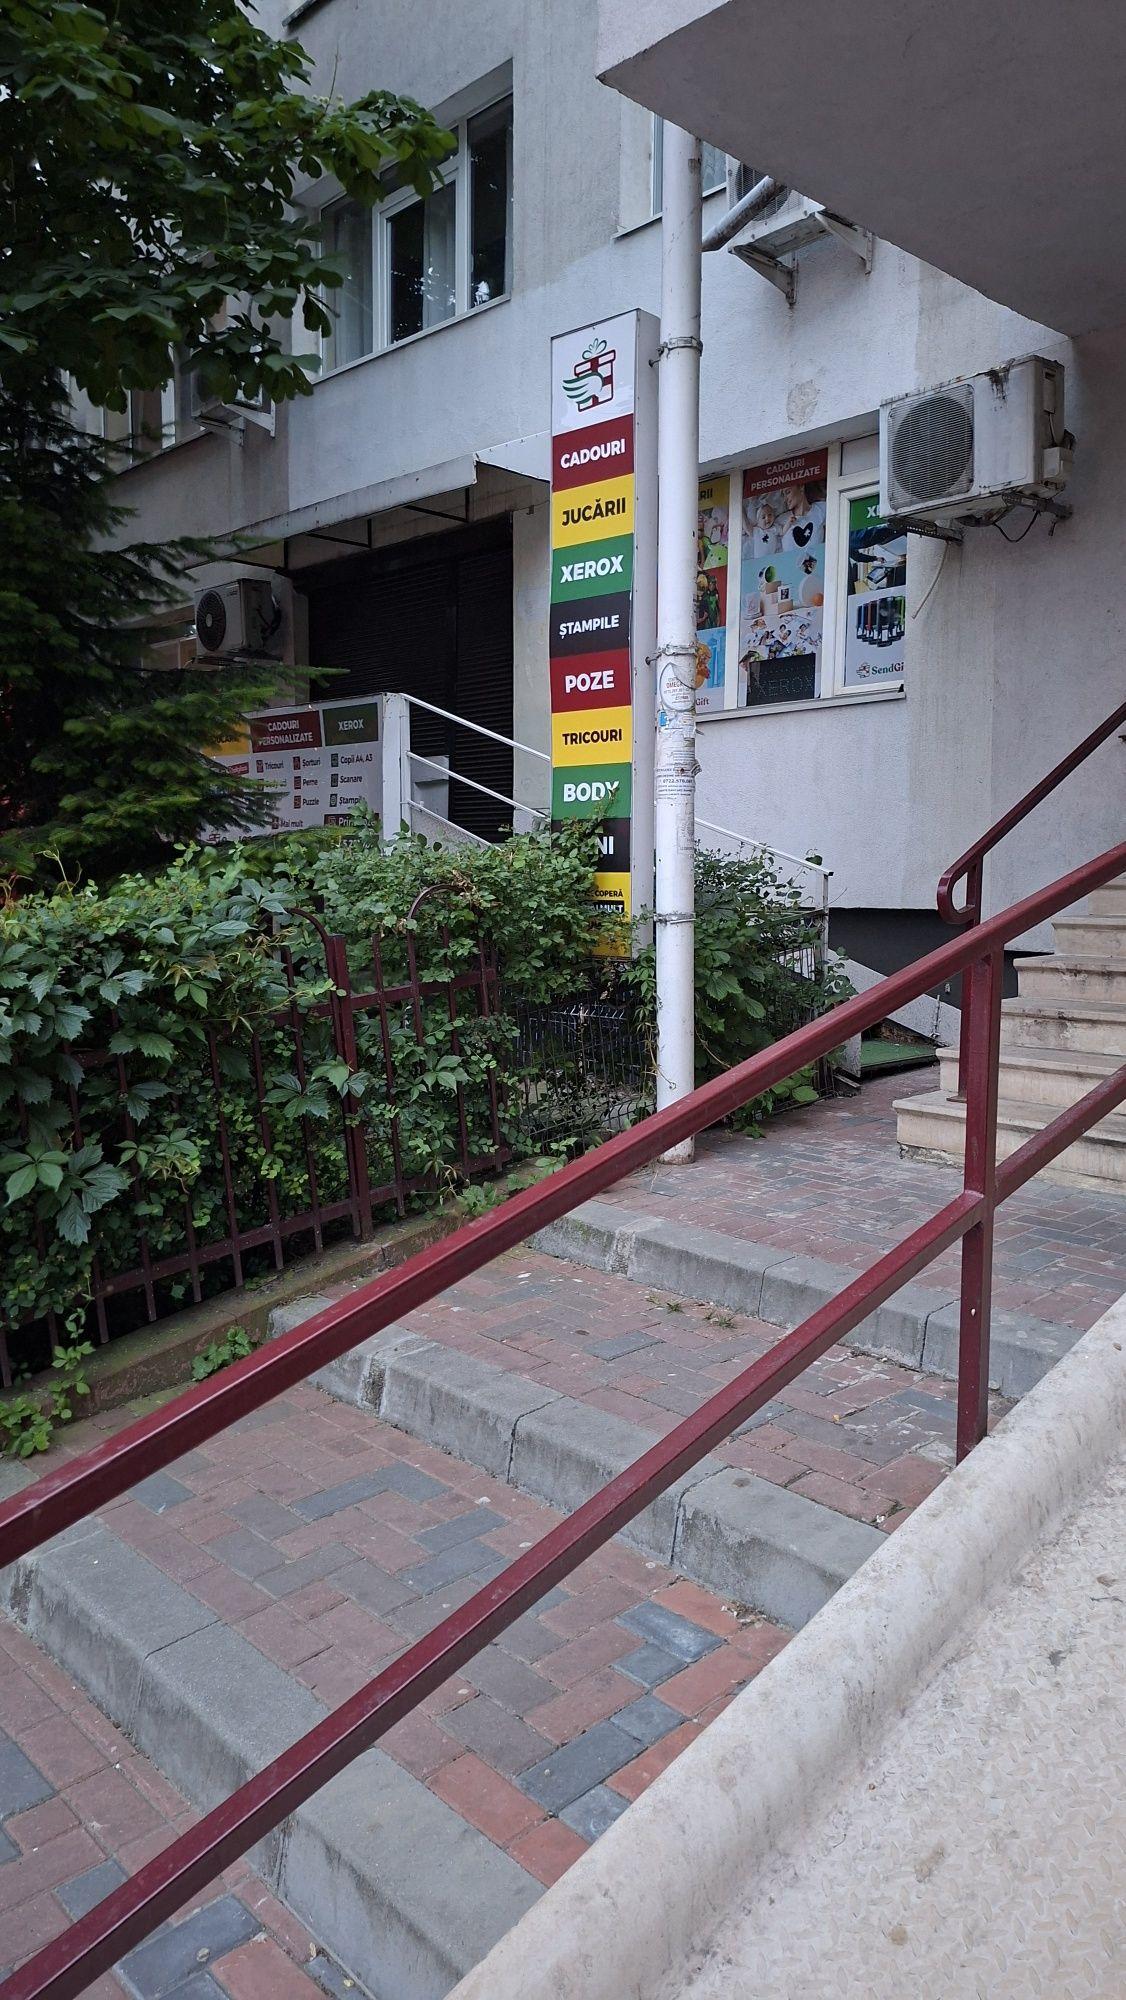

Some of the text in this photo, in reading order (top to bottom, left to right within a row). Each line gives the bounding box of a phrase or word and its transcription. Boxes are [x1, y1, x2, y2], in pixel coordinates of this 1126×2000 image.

[560, 438, 626, 469] CADOURI
[766, 457, 805, 475] CADOURI
[751, 465, 821, 491] PERSONALIZATE
[562, 497, 626, 526] JUCĂRII
[560, 555, 624, 583] XEROX
[871, 661, 905, 675] SendGi
[565, 670, 615, 693] POZE
[695, 697, 710, 706] Gift
[268, 720, 299, 732] CADOURI
[338, 719, 364, 731] XEROX
[258, 732, 313, 746] PERSONALIZATE
[562, 728, 622, 745] TRICOURI
[364, 753, 373, 762] A3
[265, 760, 284, 770] Tricouri
[303, 778, 318, 787] Perne
[340, 775, 362, 784] Scanare
[563, 781, 619, 802] BODY
[303, 797, 319, 806] Puzzle
[595, 836, 614, 855] NI
[586, 888, 624, 898] COPERĂ
